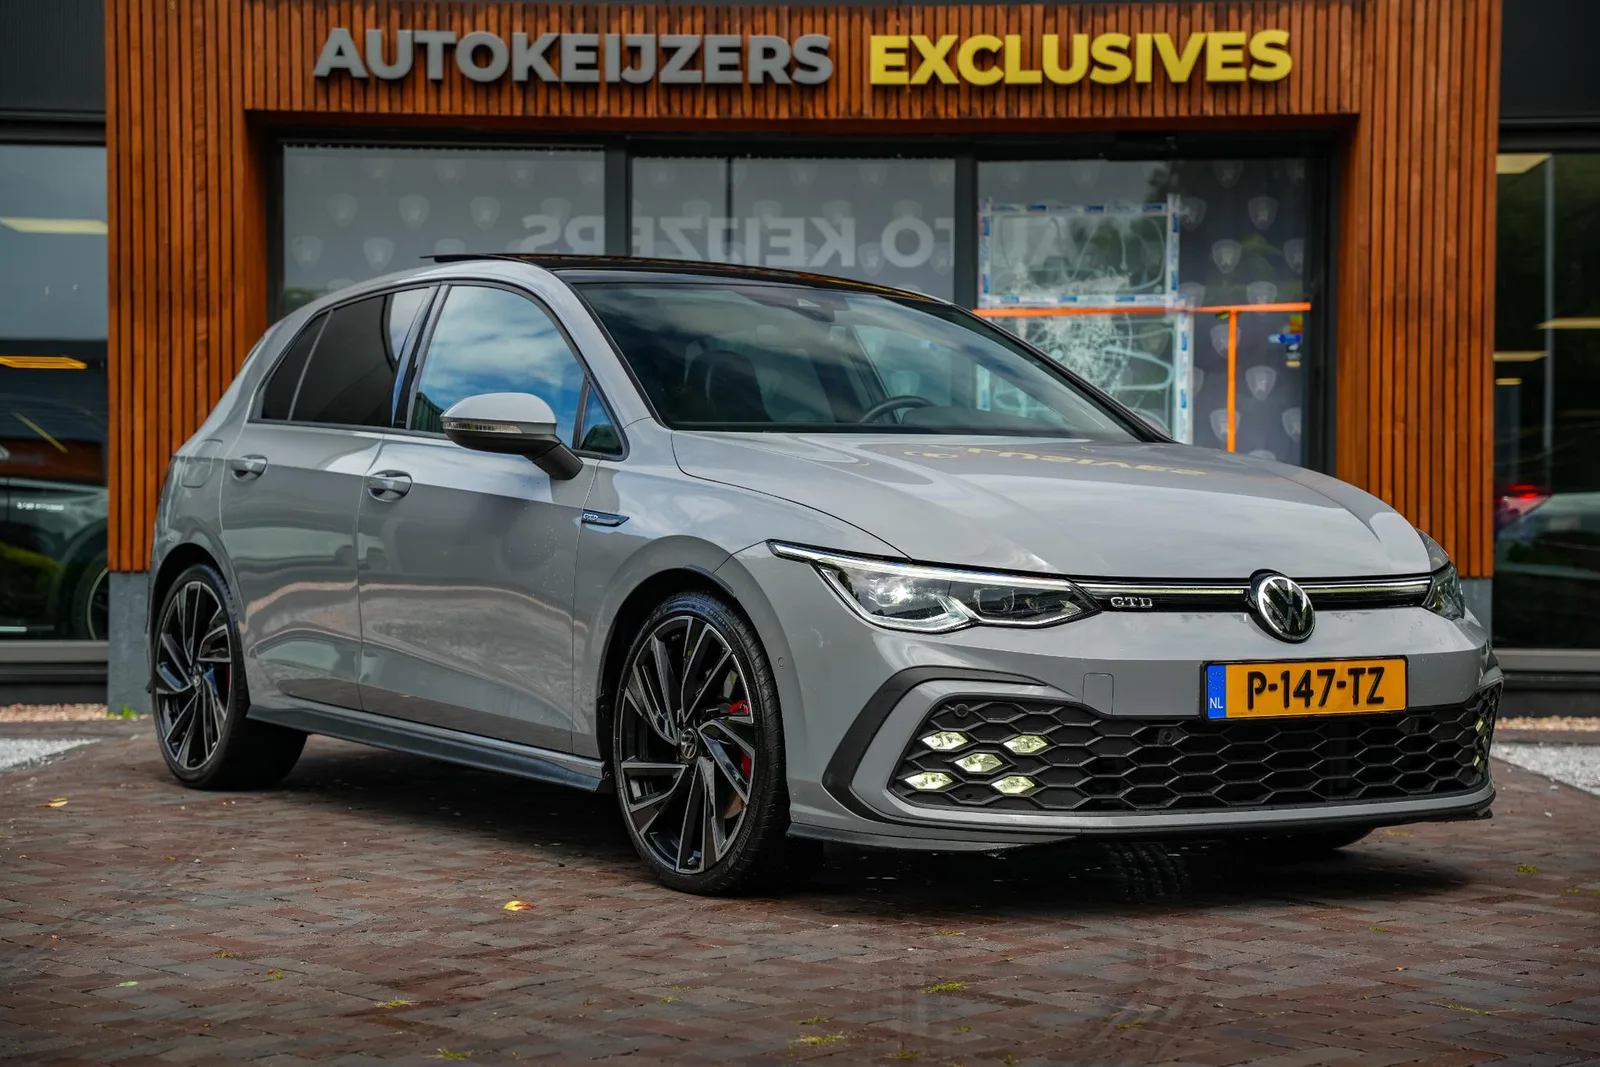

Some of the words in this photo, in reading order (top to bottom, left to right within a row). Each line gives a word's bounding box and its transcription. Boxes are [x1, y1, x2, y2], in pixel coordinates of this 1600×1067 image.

[313, 28, 834, 86] AUTOKEIJZERS
[870, 29, 1294, 86] EXCLUSIVES
[1110, 596, 1153, 608] GTD
[1247, 666, 1385, 710] P-147-TZ
[1209, 697, 1224, 709] NL
